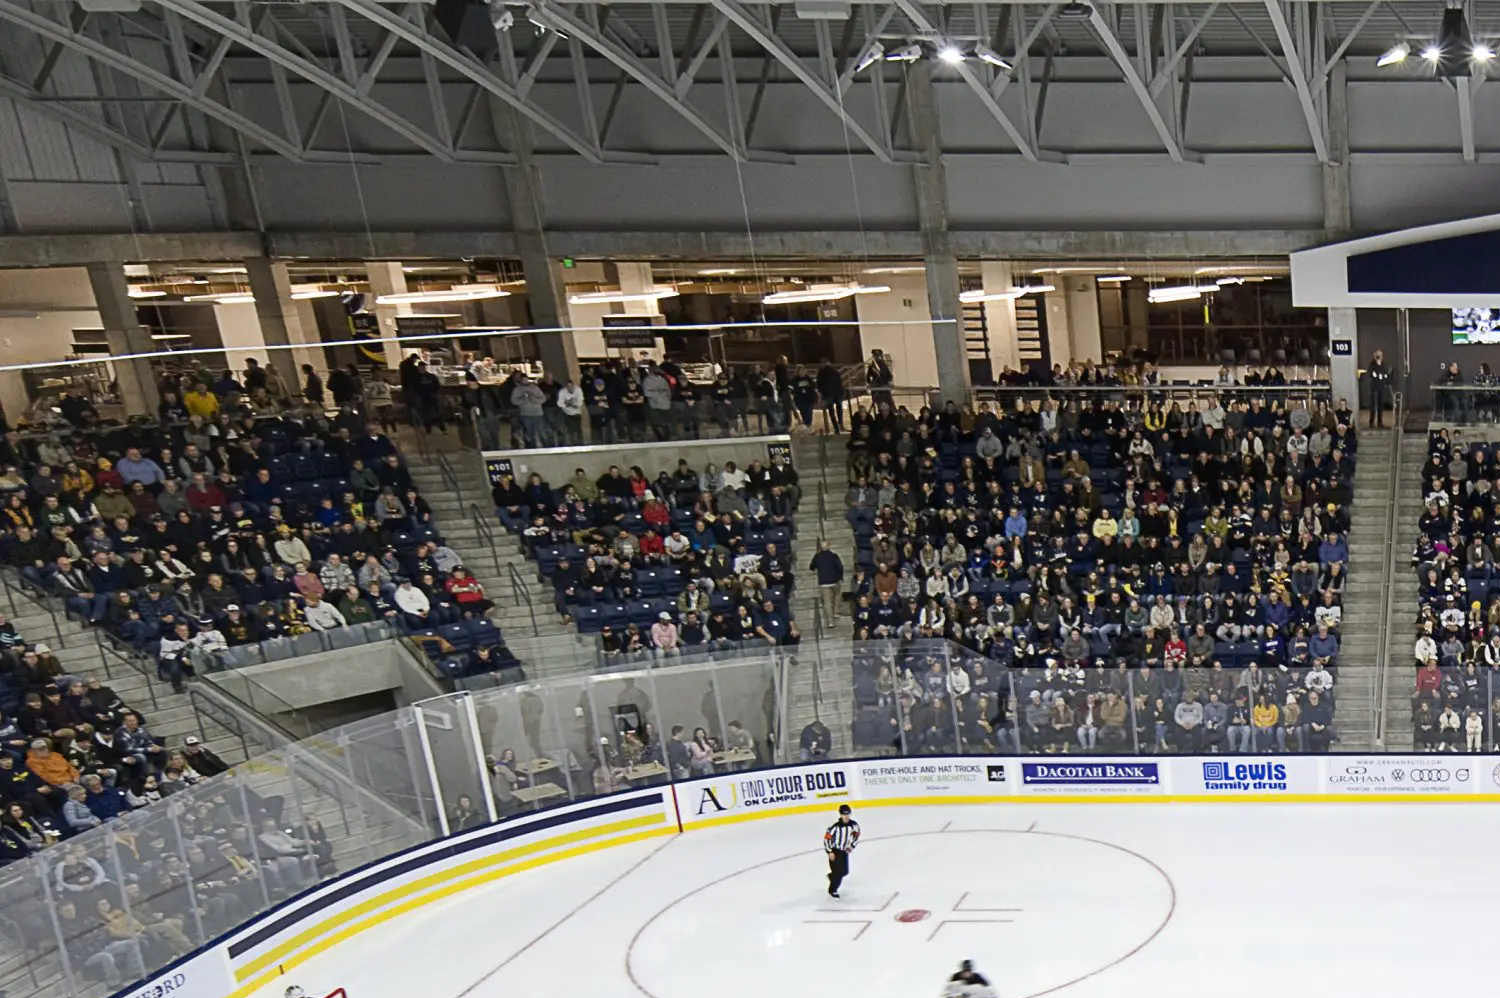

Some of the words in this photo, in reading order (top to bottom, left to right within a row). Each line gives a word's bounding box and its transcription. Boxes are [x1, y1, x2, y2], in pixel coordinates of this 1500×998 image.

[1335, 343, 1349, 351] 103
[863, 767, 879, 777] FOR
[880, 765, 918, 777] FIVE-HOLE
[920, 766, 937, 774] AND
[938, 765, 953, 773] HAT
[1037, 765, 1102, 779] DACOTAH
[1106, 765, 1145, 778] BANK
[1223, 761, 1287, 782] Lewis
[740, 779, 766, 799] FIND
[768, 774, 803, 795] YOUR
[805, 770, 848, 793] BOLD
[898, 775, 919, 785] ONLY
[919, 774, 936, 783] ONE
[937, 773, 978, 783] ARCHITECT
[1329, 775, 1385, 783] GRAHAM
[1204, 781, 1250, 791] family
[1252, 781, 1288, 791] drug
[744, 798, 759, 807] ON
